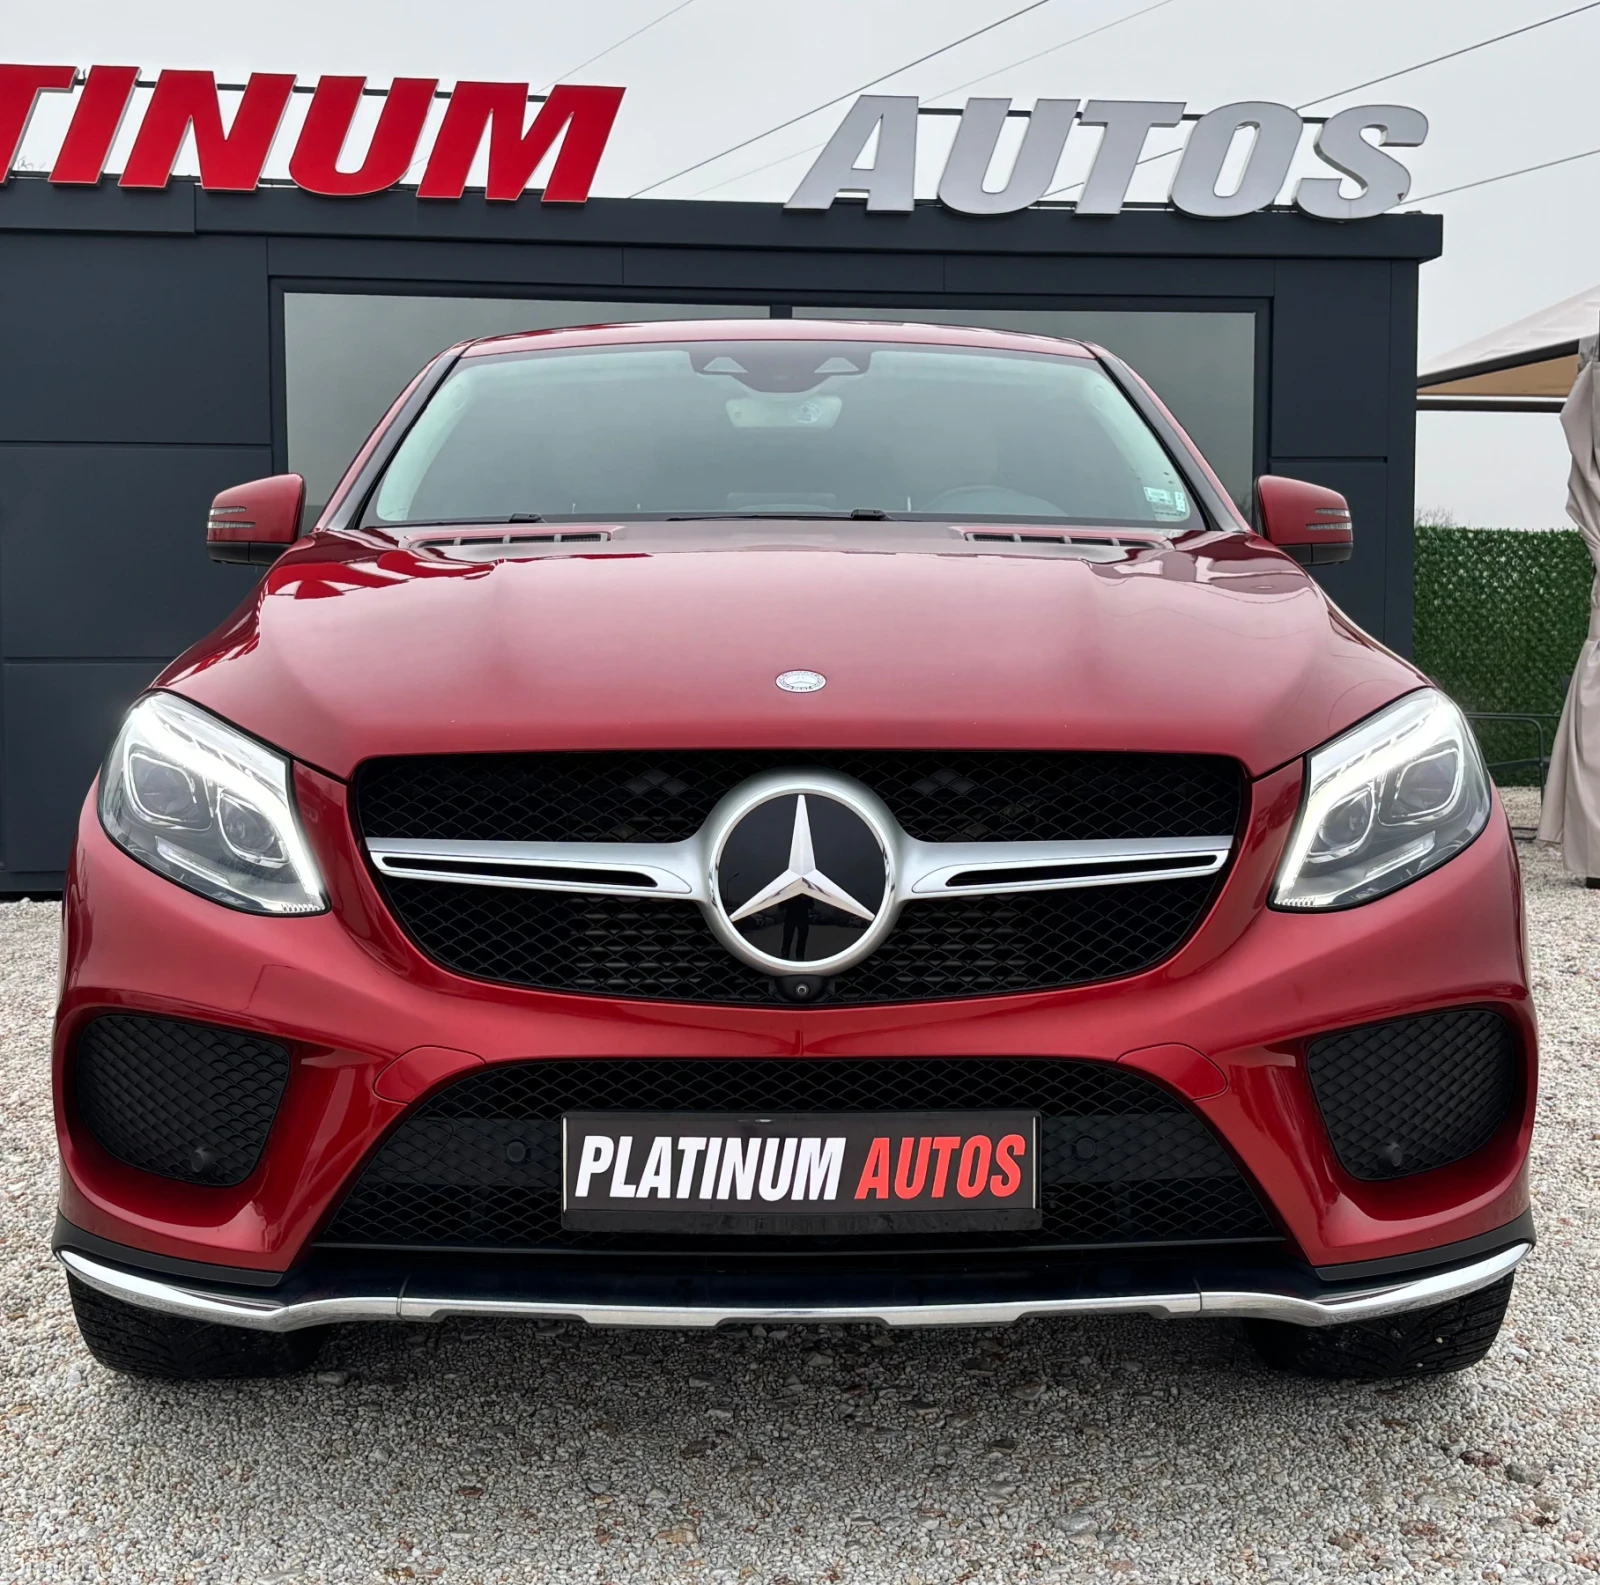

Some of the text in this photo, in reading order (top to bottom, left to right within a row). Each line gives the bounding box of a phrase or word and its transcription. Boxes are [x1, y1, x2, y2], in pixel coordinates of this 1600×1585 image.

[783, 95, 1428, 220] AUTOS
[575, 1134, 1027, 1202] PLATINUM AUTOS
